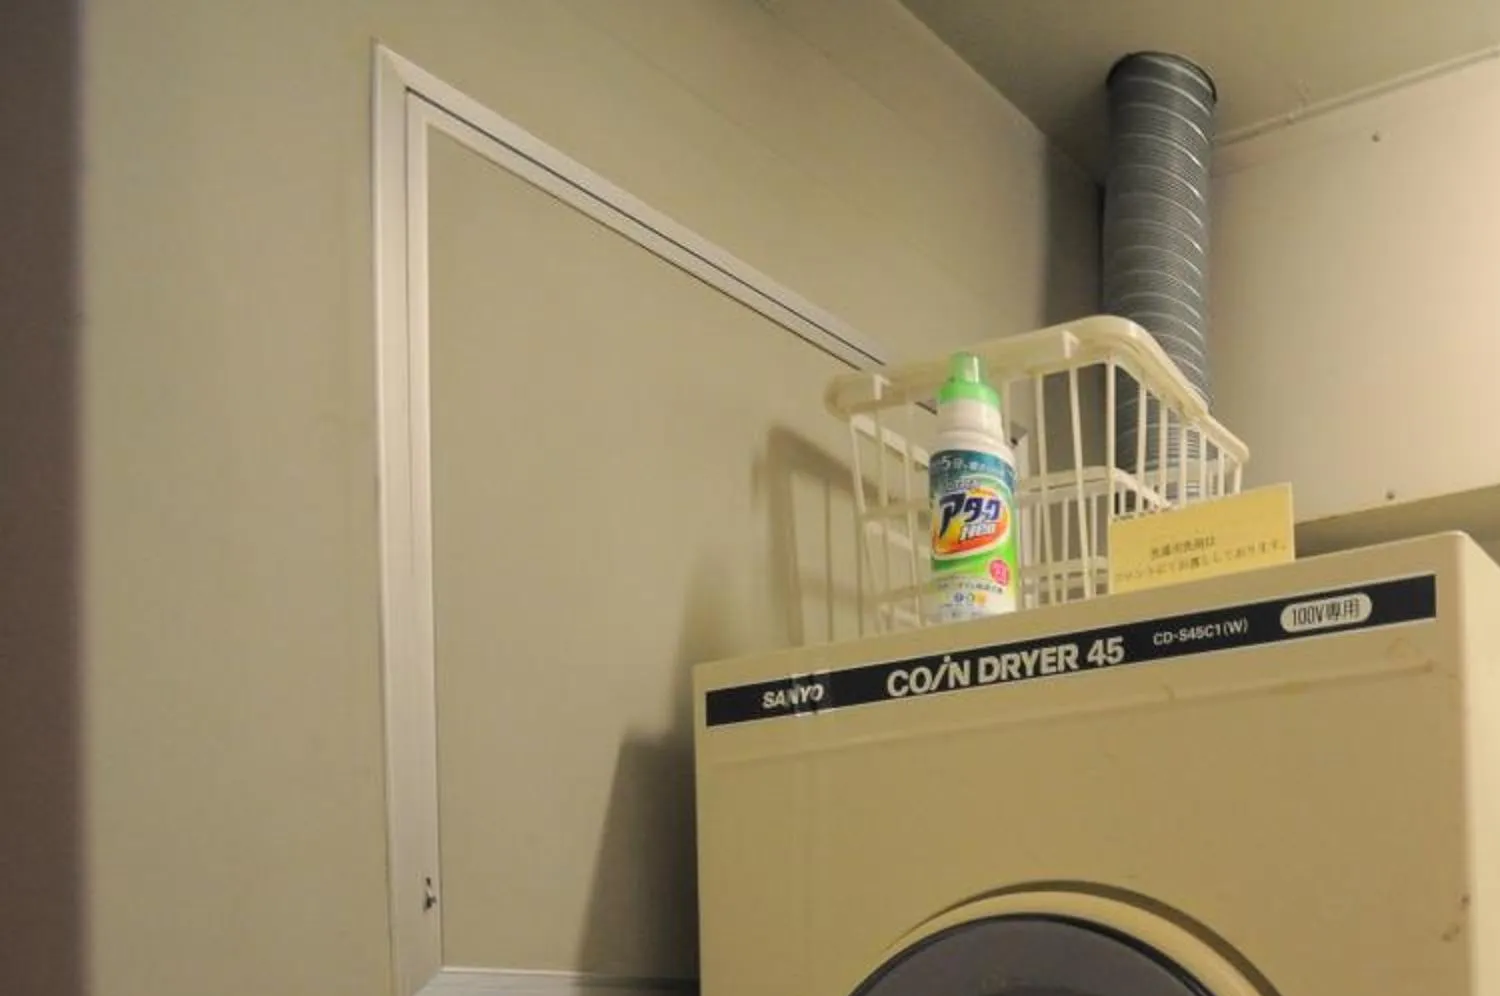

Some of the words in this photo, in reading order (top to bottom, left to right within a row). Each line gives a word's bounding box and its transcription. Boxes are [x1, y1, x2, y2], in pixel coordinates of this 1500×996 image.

[978, 643, 1079, 685] DRYER
[1087, 636, 1125, 666] 45
[763, 683, 825, 709] SANYO
